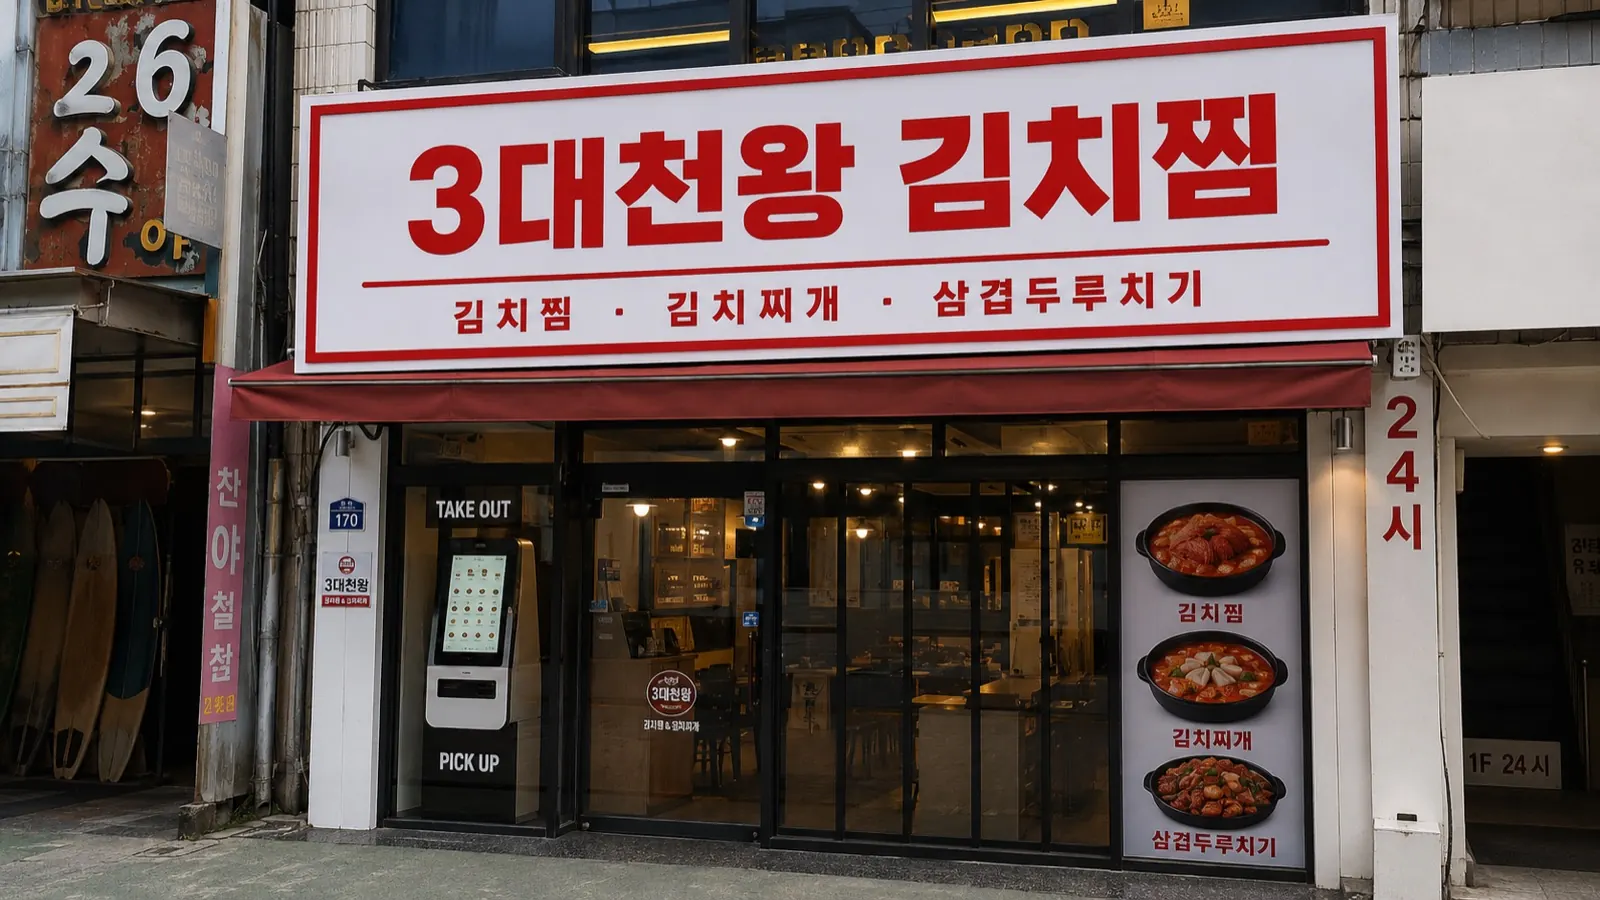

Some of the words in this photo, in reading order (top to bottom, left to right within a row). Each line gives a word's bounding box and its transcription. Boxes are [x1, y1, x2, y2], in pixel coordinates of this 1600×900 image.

[53, 19, 194, 118] 26
[408, 122, 855, 255] 3대천왕
[899, 92, 1278, 232] 김치찜
[40, 127, 132, 265] 수
[454, 296, 571, 334] 김치찜
[667, 285, 838, 327] 김치찌개
[933, 269, 1202, 318] 삼겹두루치기
[1383, 396, 1422, 550] 24시
[336, 513, 358, 528] 170
[436, 500, 475, 519] TAKE
[479, 500, 511, 519] OUT
[324, 578, 369, 593] 3대천왕
[1179, 603, 1244, 624] 김치찜
[1173, 728, 1252, 750] 김치찌개
[439, 752, 475, 771] PICK
[479, 753, 500, 773] UP
[1468, 752, 1492, 774] 1F
[1152, 830, 1277, 858] 삼겹두루치기
